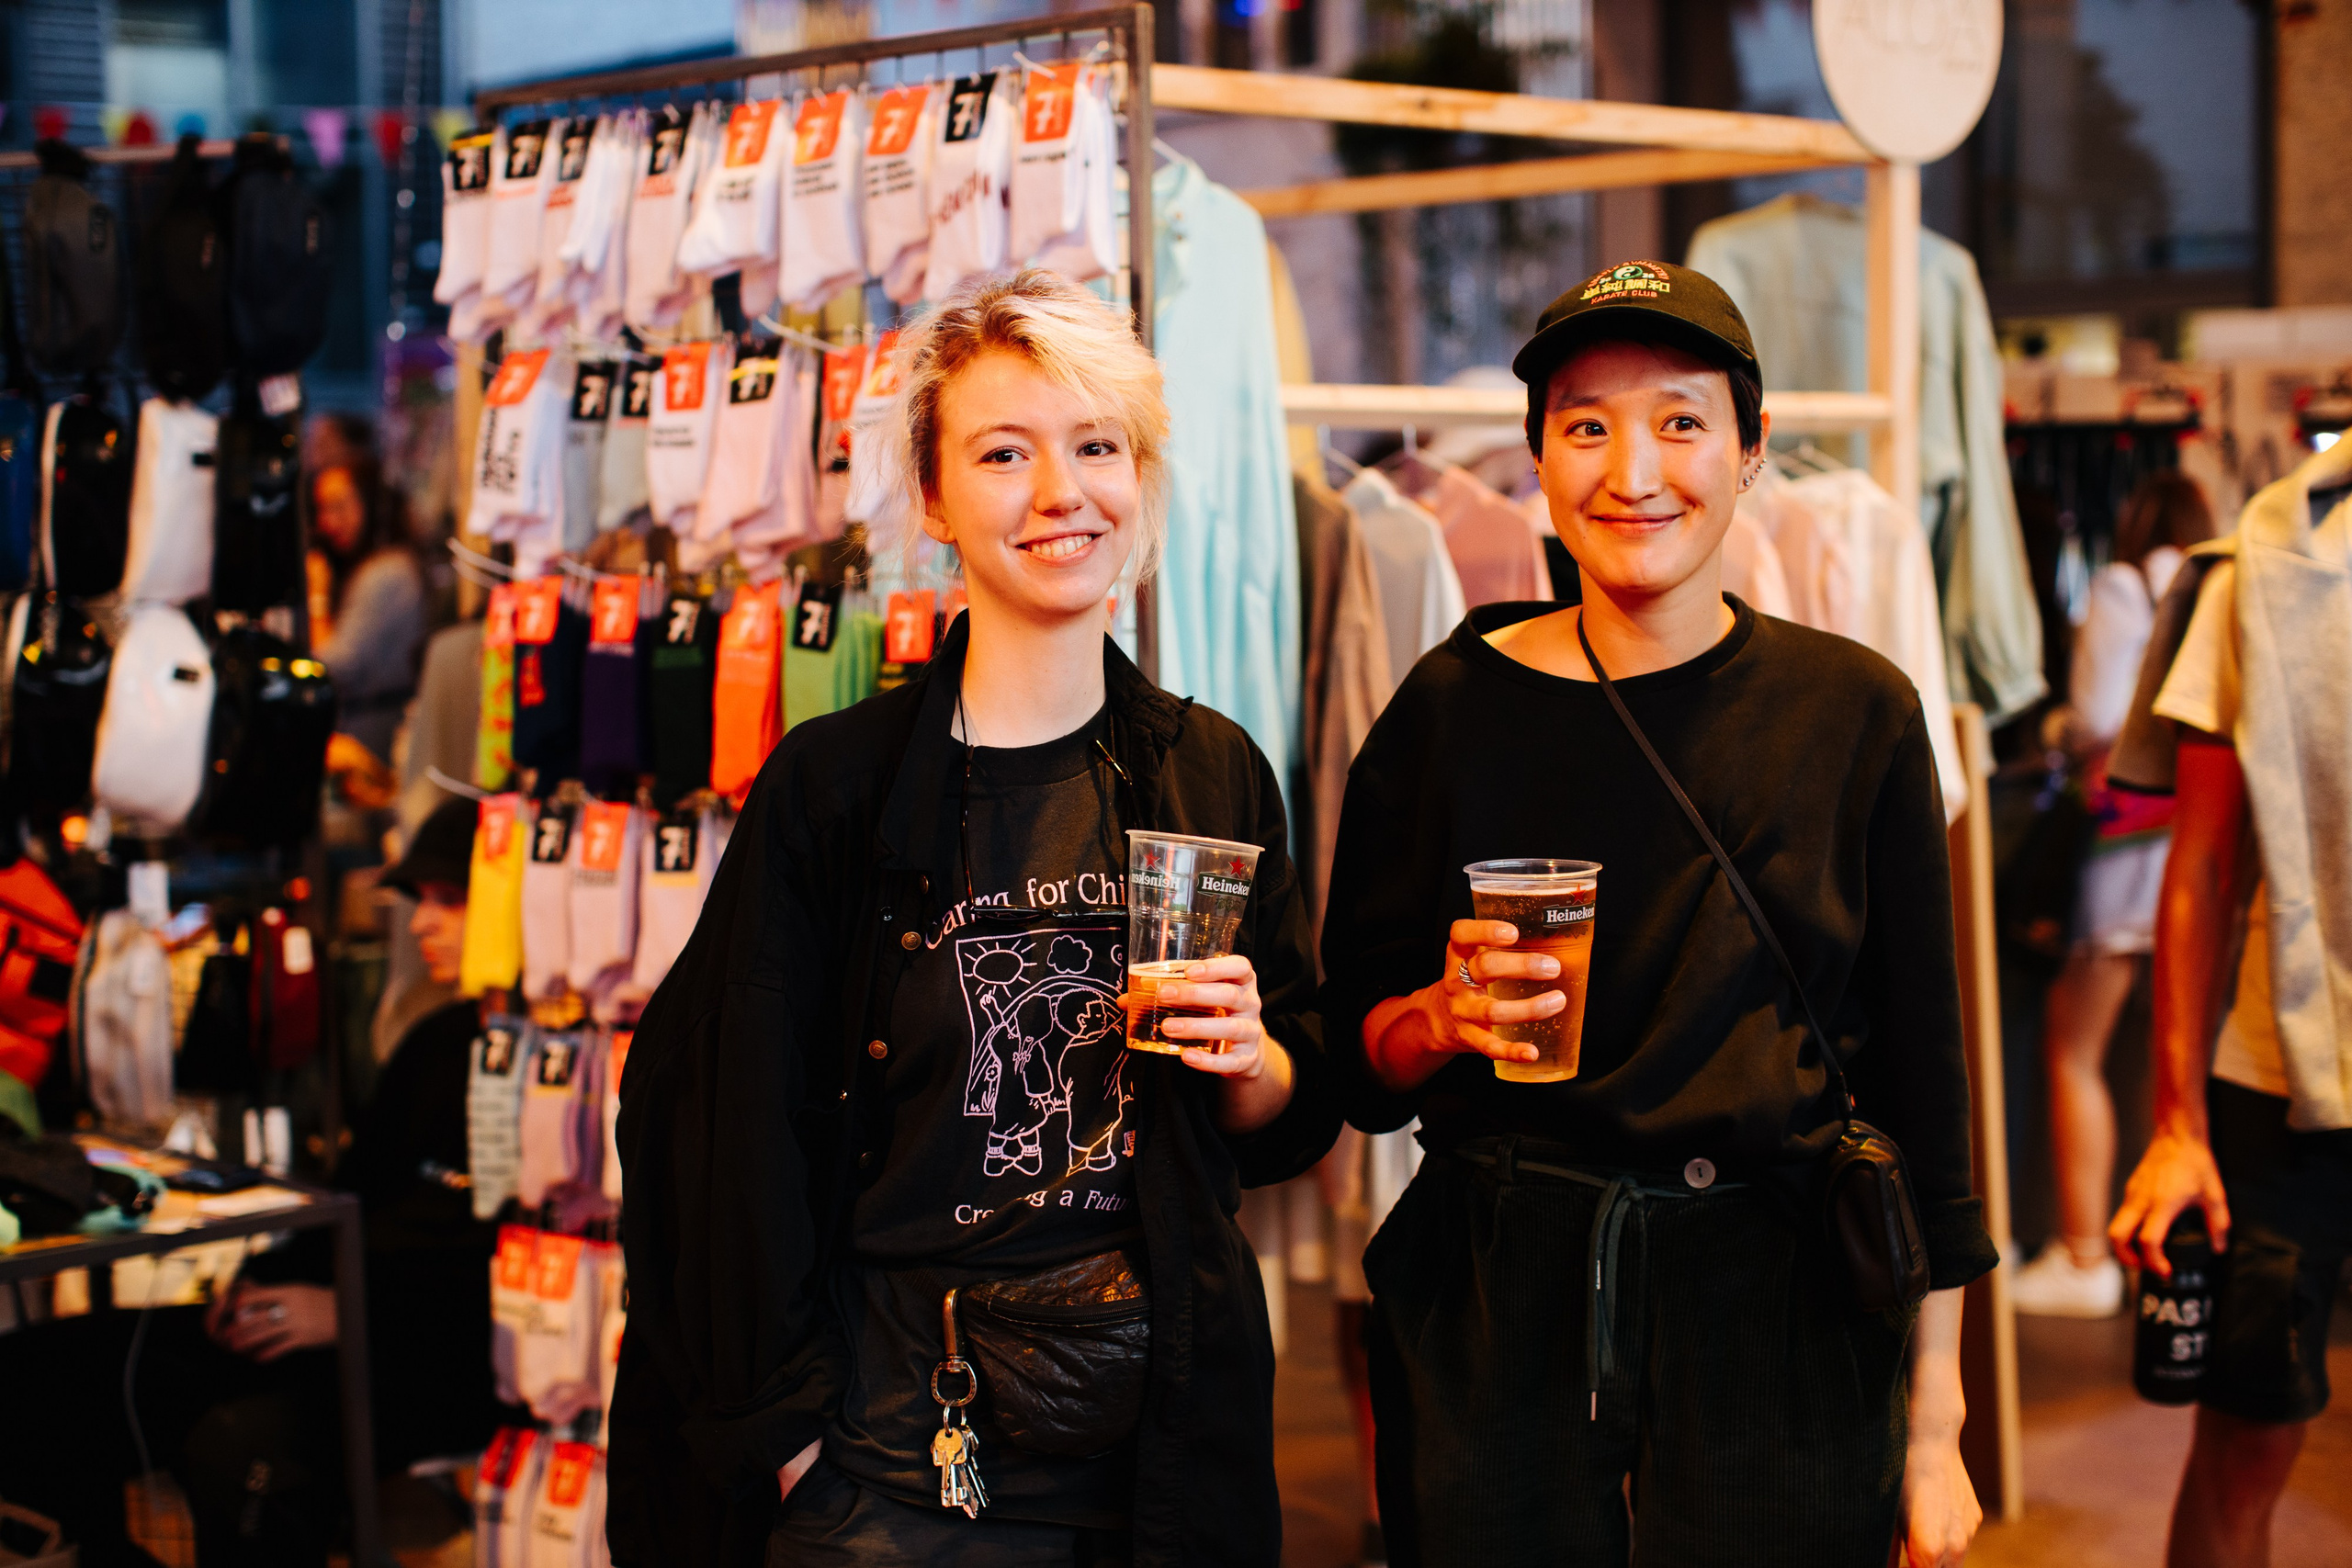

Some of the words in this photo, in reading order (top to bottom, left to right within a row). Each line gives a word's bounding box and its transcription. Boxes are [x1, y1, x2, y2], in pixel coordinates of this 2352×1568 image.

[953, 93, 975, 137] 7
[1035, 93, 1055, 134] 7
[1590, 289, 1628, 304] KARATE
[1631, 289, 1658, 298] CLUB
[1026, 878, 1069, 907] for
[1078, 874, 1125, 906] Chi
[1059, 1190, 1074, 1207] a
